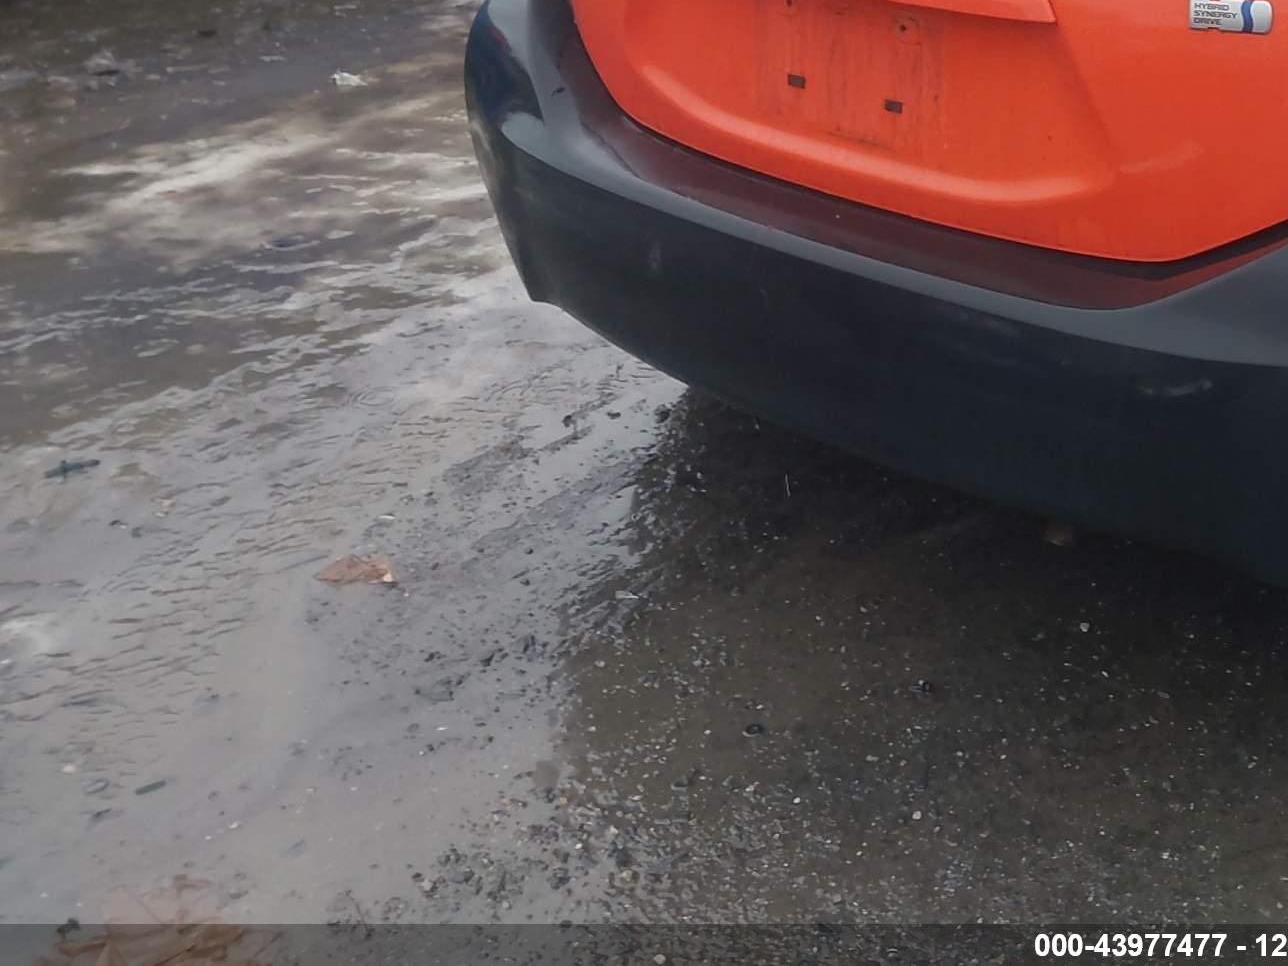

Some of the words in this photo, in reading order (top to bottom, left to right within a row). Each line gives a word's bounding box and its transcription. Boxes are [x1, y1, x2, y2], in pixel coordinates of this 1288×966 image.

[1194, 2, 1230, 11] HYBRID
[1193, 9, 1238, 19] SYNERGY
[1193, 17, 1222, 26] DRIVE
